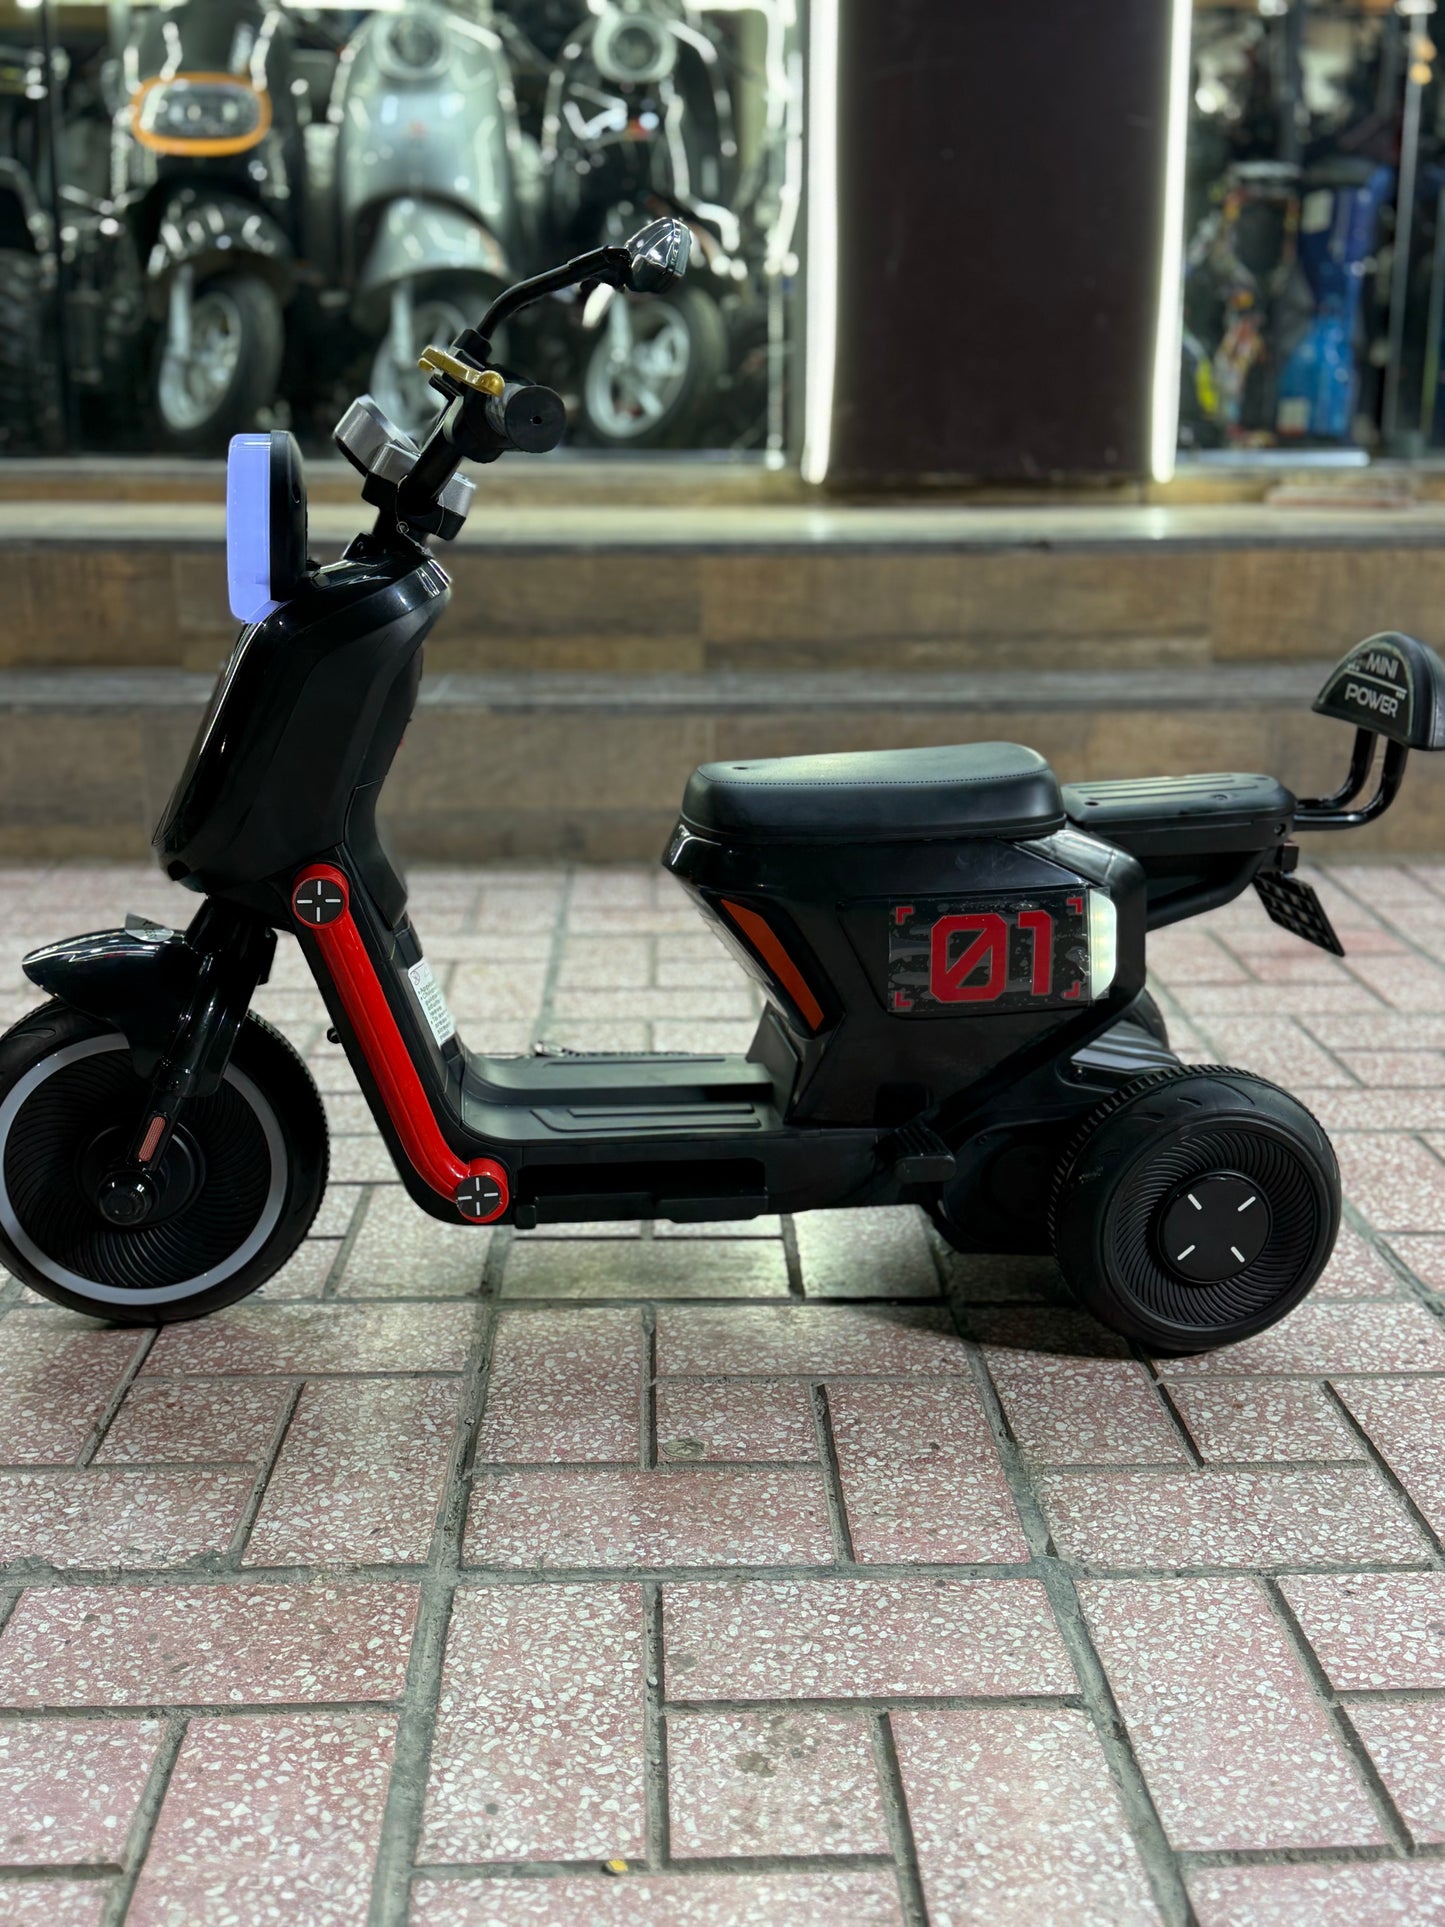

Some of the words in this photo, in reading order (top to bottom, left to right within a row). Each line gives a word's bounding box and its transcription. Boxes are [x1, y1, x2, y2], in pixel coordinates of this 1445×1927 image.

[1365, 652, 1399, 680] MINI
[1344, 683, 1398, 718] POWER
[930, 910, 1052, 1003] 01
